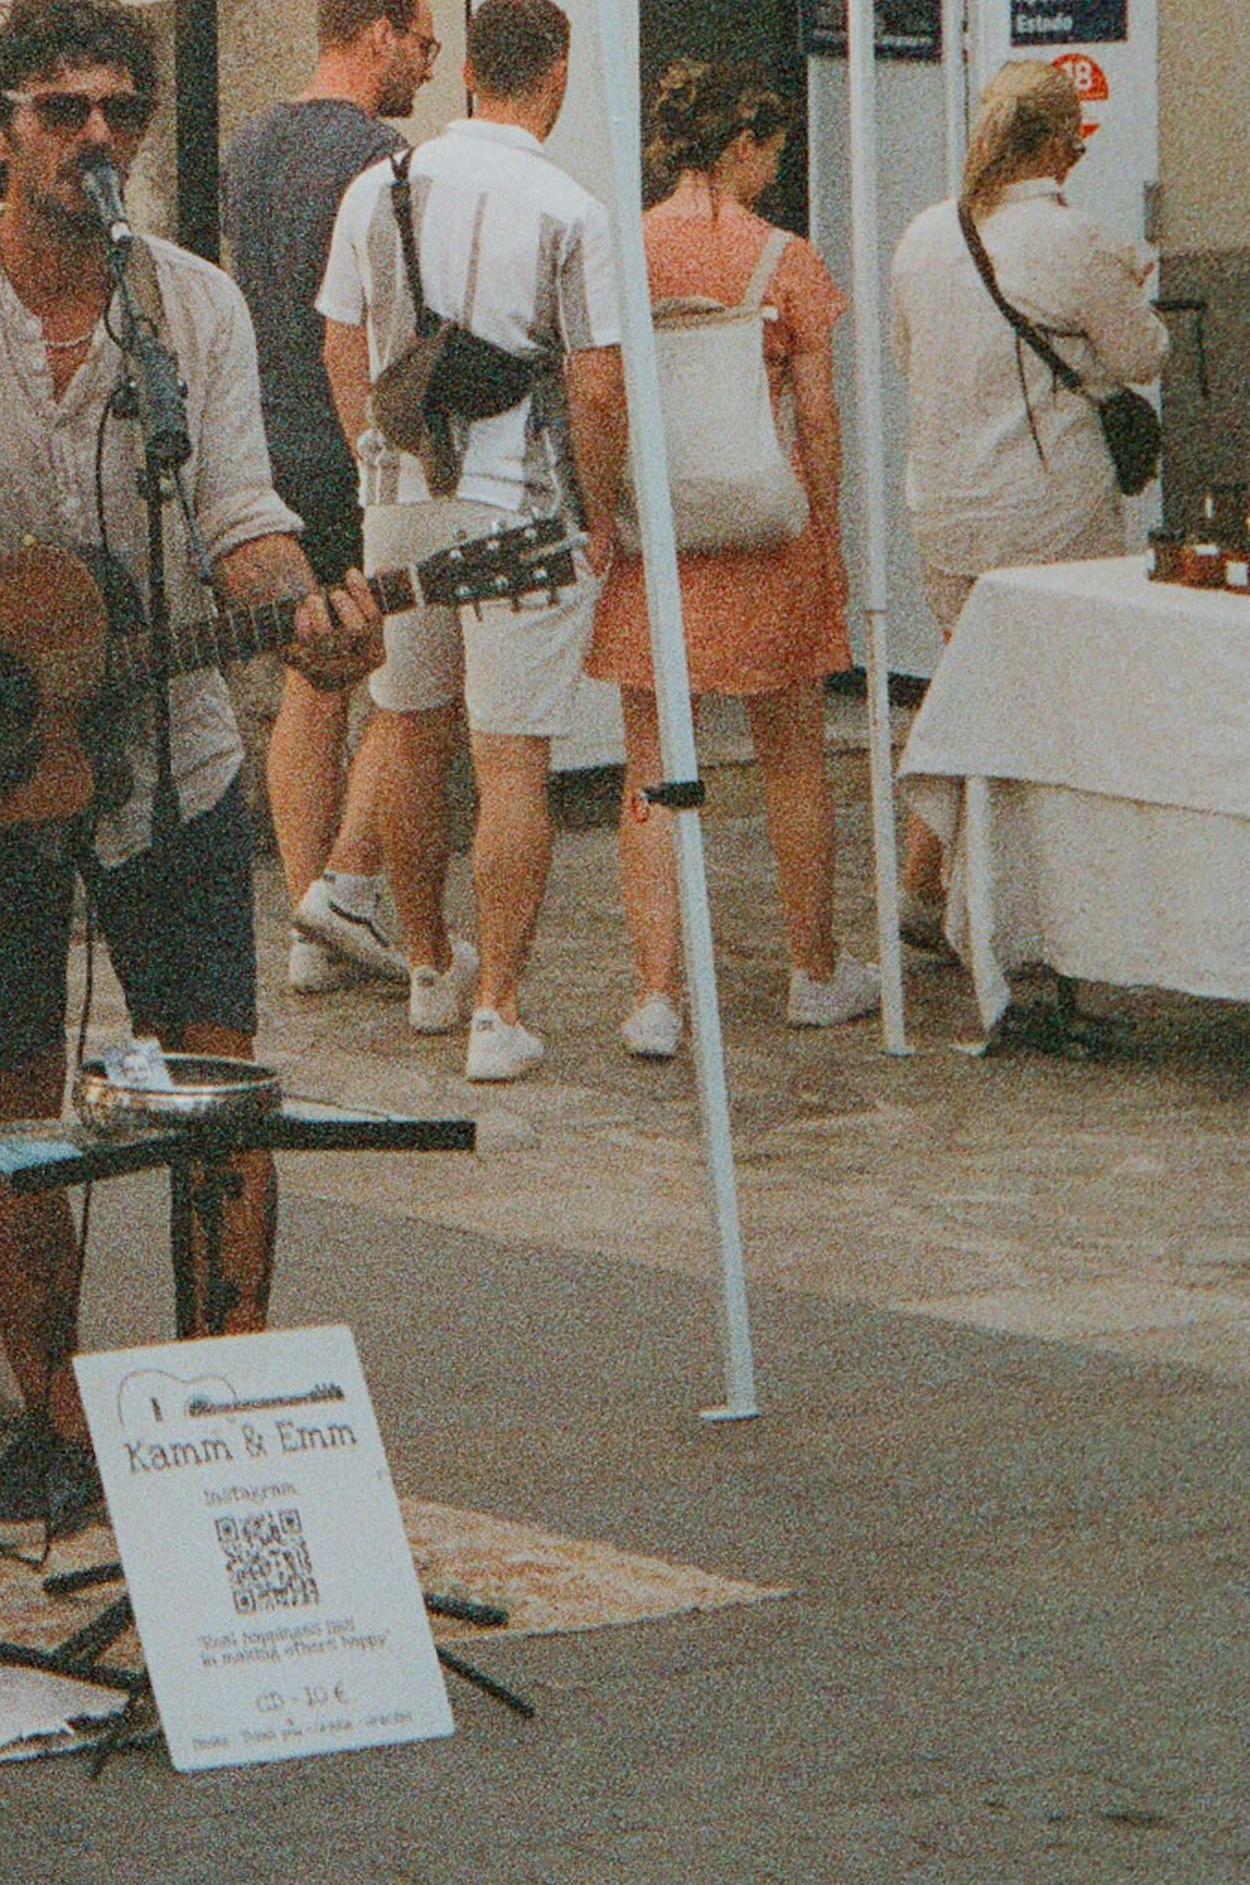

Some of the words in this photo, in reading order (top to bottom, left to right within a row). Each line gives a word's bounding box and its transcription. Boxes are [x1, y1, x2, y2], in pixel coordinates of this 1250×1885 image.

[1015, 14, 1075, 33] Estado
[124, 1436, 234, 1475] Kamm
[243, 1422, 268, 1458] &
[276, 1419, 359, 1453] Emm
[334, 1680, 349, 1706] €
